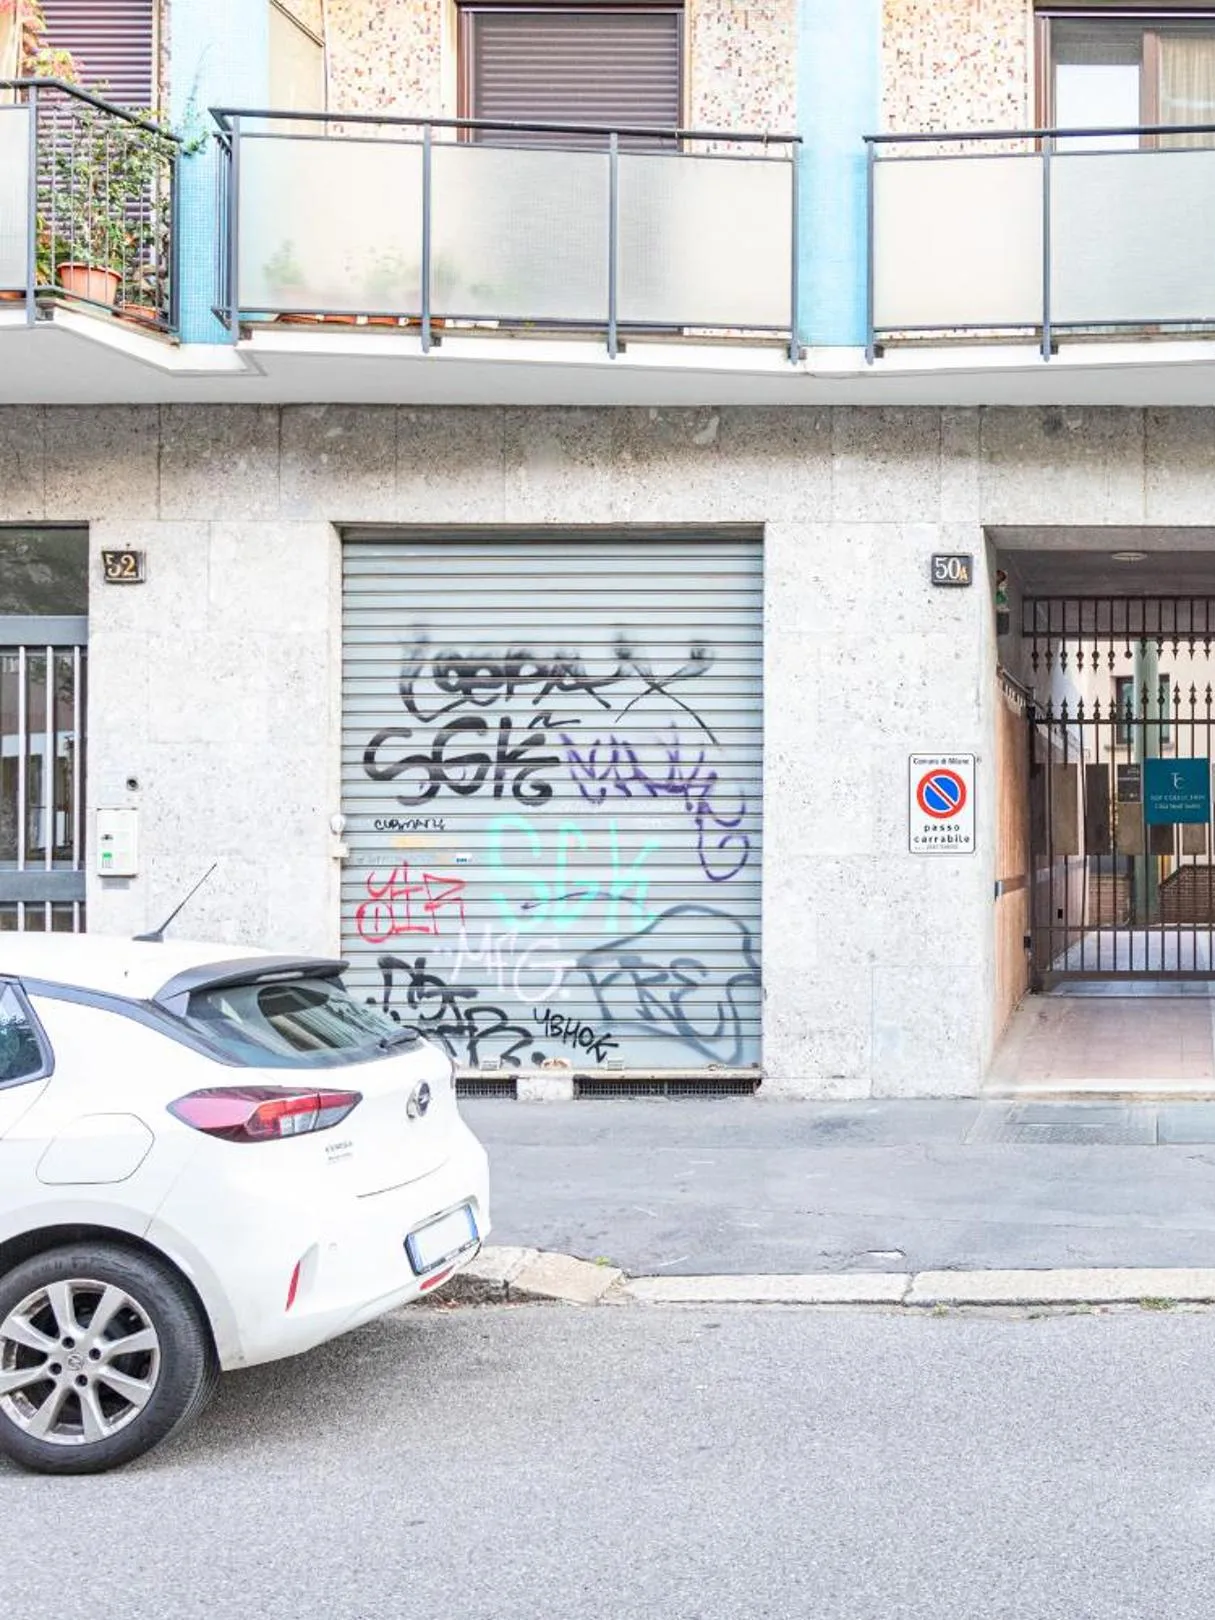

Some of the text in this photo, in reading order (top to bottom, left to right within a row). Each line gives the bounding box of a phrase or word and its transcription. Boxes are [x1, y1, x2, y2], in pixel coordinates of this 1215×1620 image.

[105, 553, 137, 578] 52
[923, 824, 960, 833] passo
[913, 833, 970, 843] carrabile
